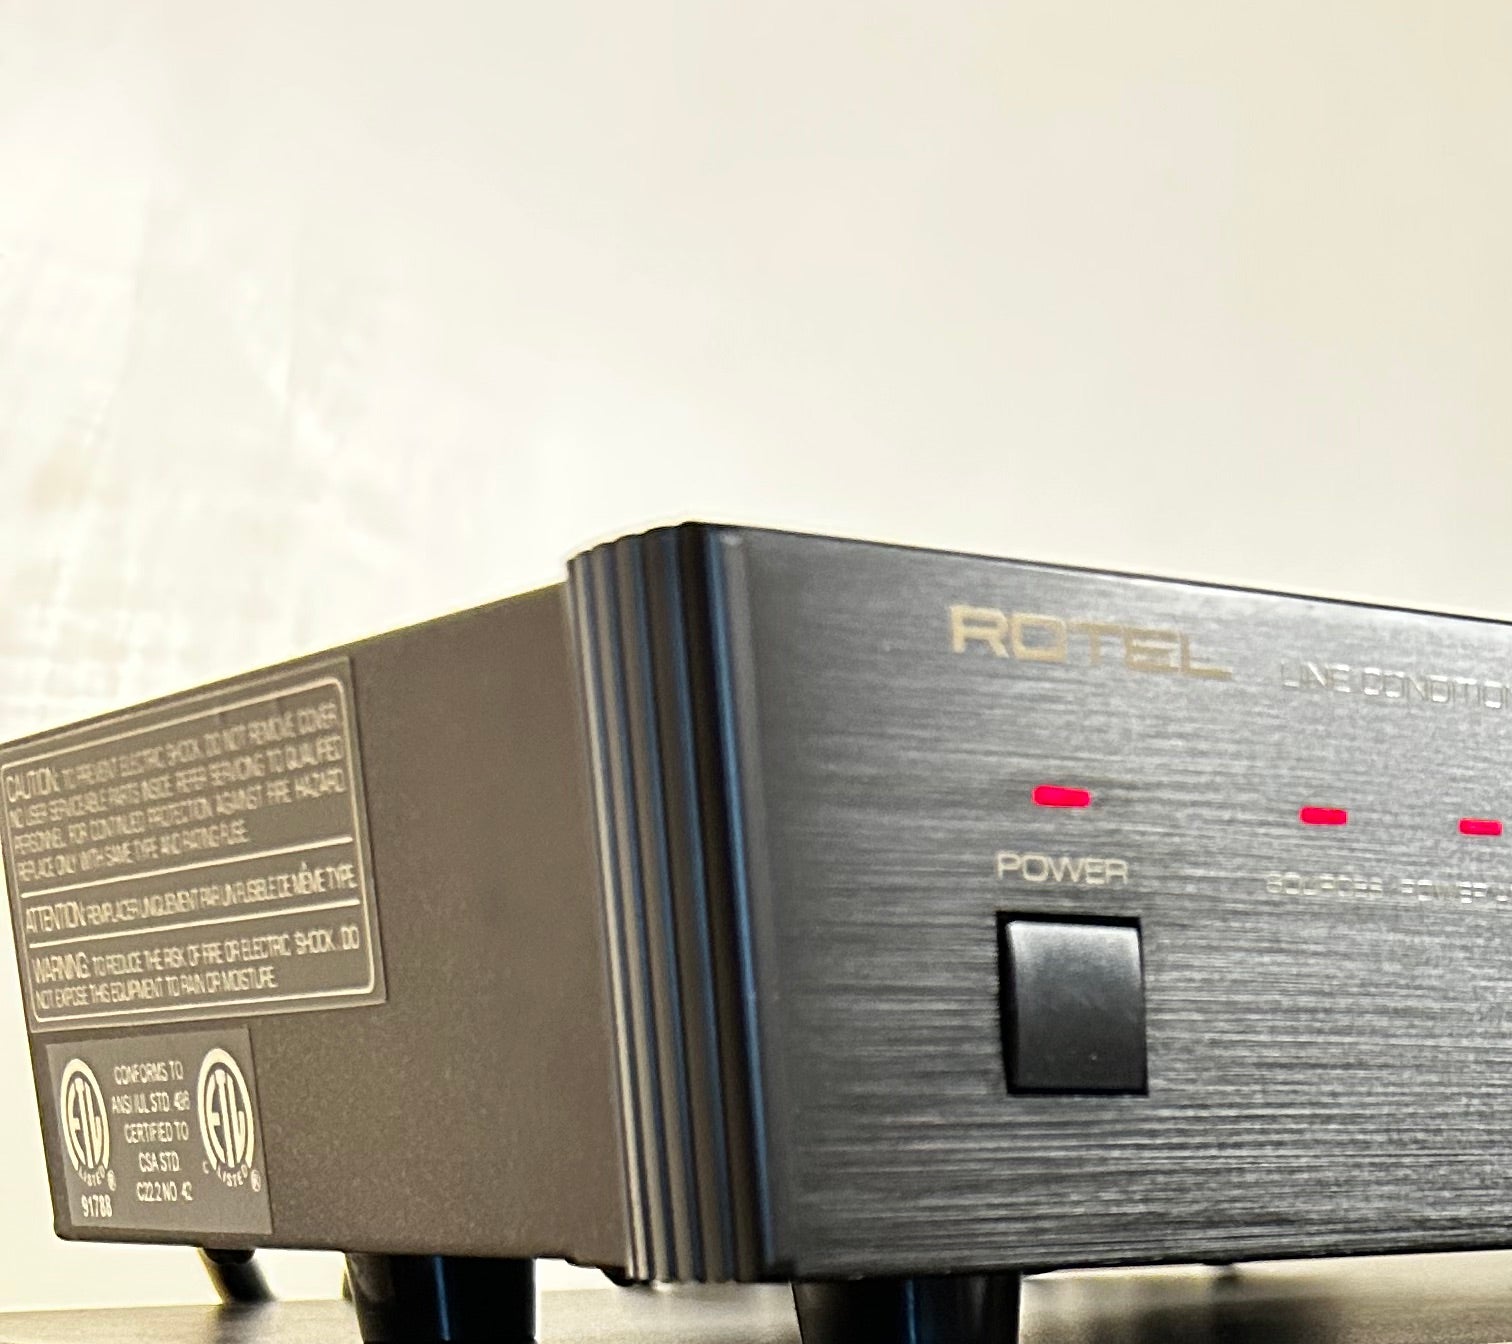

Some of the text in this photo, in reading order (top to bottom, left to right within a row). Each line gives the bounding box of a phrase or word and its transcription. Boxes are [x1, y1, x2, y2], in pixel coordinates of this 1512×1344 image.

[950, 603, 1233, 681] ROTEL
[1281, 661, 1350, 693] LINE
[996, 851, 1128, 884] POWER
[339, 925, 360, 949] DO
[114, 1060, 184, 1085] CONFORMS TO
[124, 1121, 189, 1143] CERTIFIED TO
[138, 1152, 159, 1173] CSA
[217, 1164, 248, 1188] LISTED
